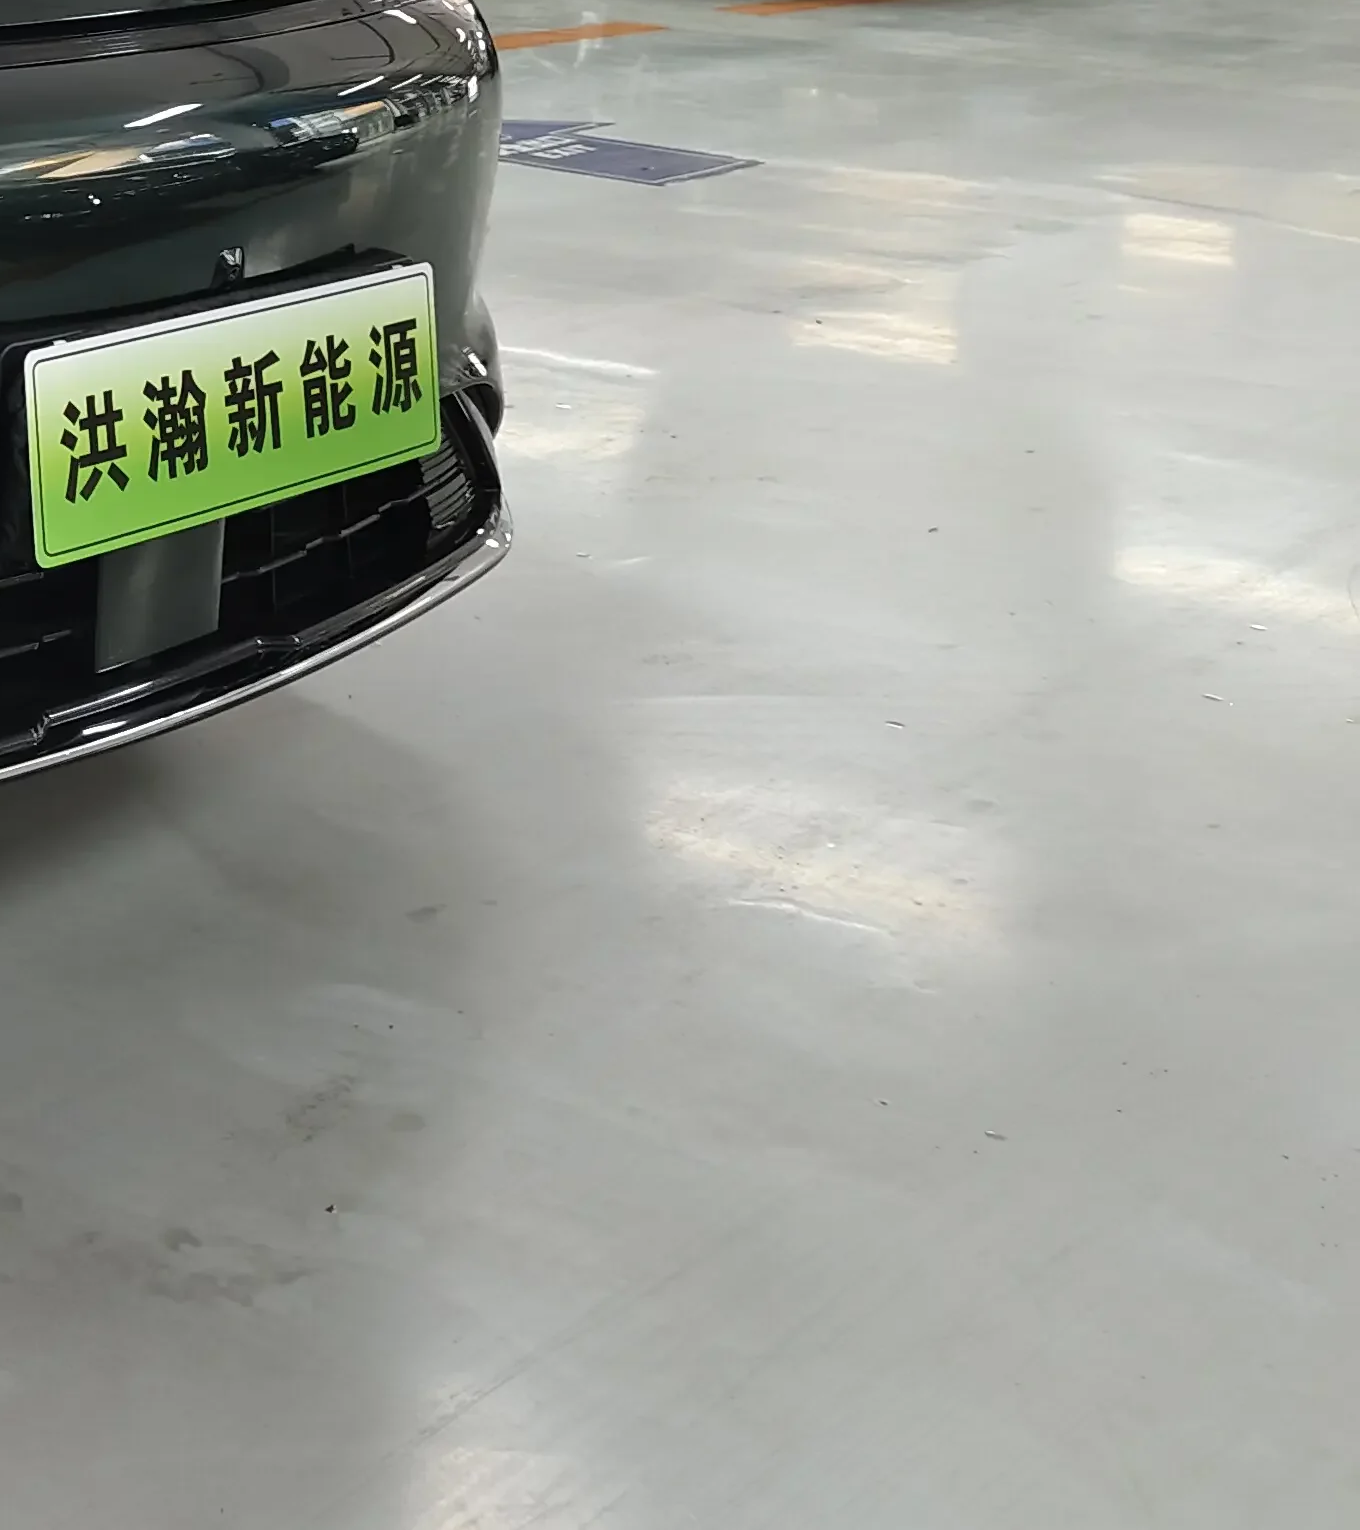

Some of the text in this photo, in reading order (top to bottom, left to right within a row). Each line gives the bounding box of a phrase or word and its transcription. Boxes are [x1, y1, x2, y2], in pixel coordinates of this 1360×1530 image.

[60, 317, 423, 504] 洪瀚新能源
